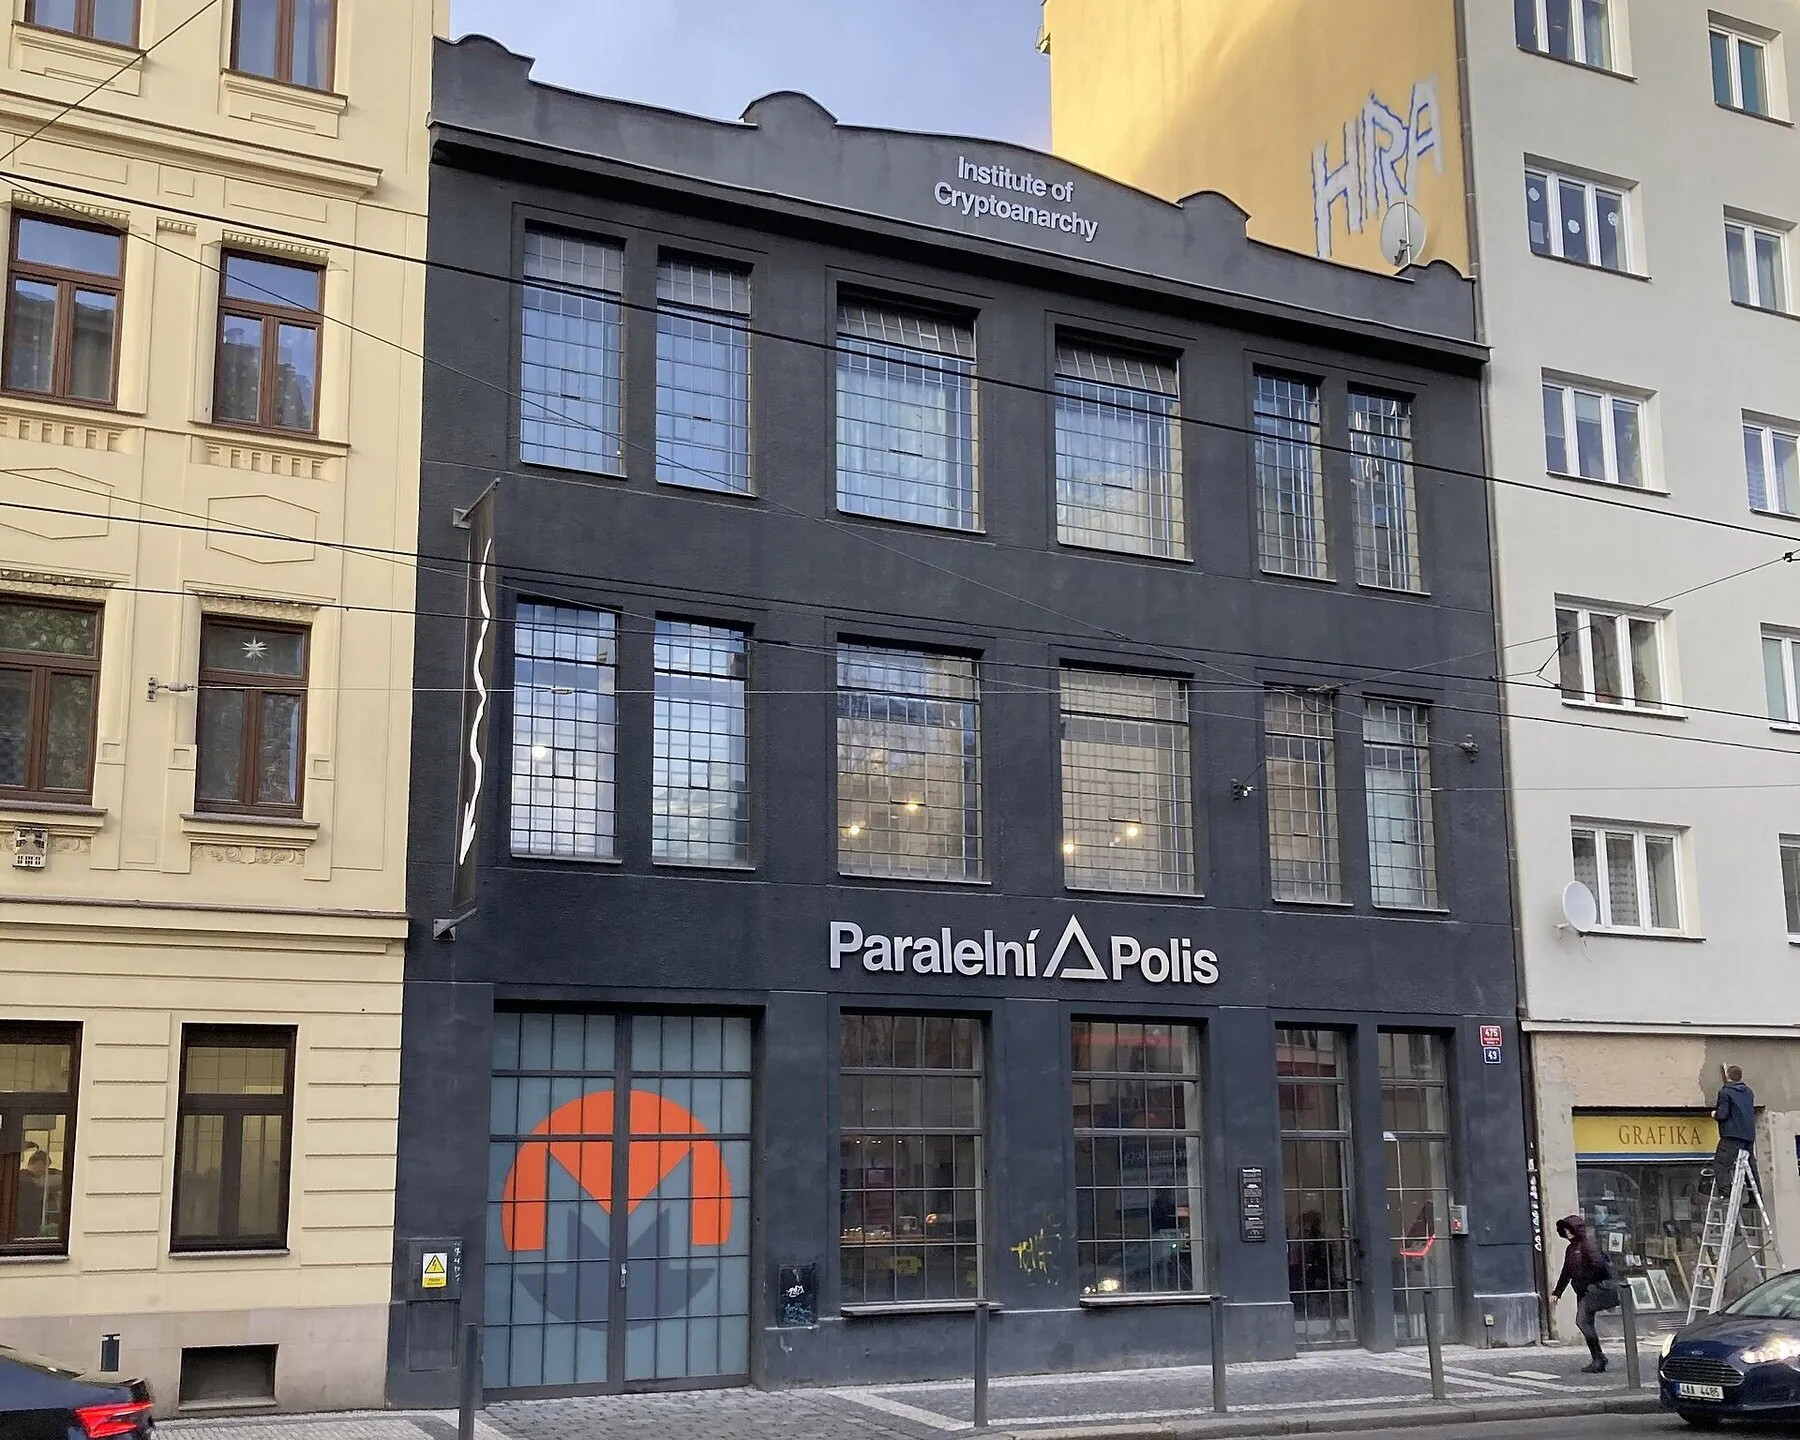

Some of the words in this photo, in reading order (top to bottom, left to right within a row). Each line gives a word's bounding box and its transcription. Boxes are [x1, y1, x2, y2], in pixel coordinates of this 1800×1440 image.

[958, 156, 1047, 197] Institute
[1051, 181, 1074, 203] of
[934, 181, 1099, 242] Cryptoanarchy
[829, 921, 1041, 978] Paralelní
[1110, 935, 1220, 984] Polis
[1485, 1028, 1498, 1037] 475
[1618, 1125, 1702, 1145] GRAFIKA
